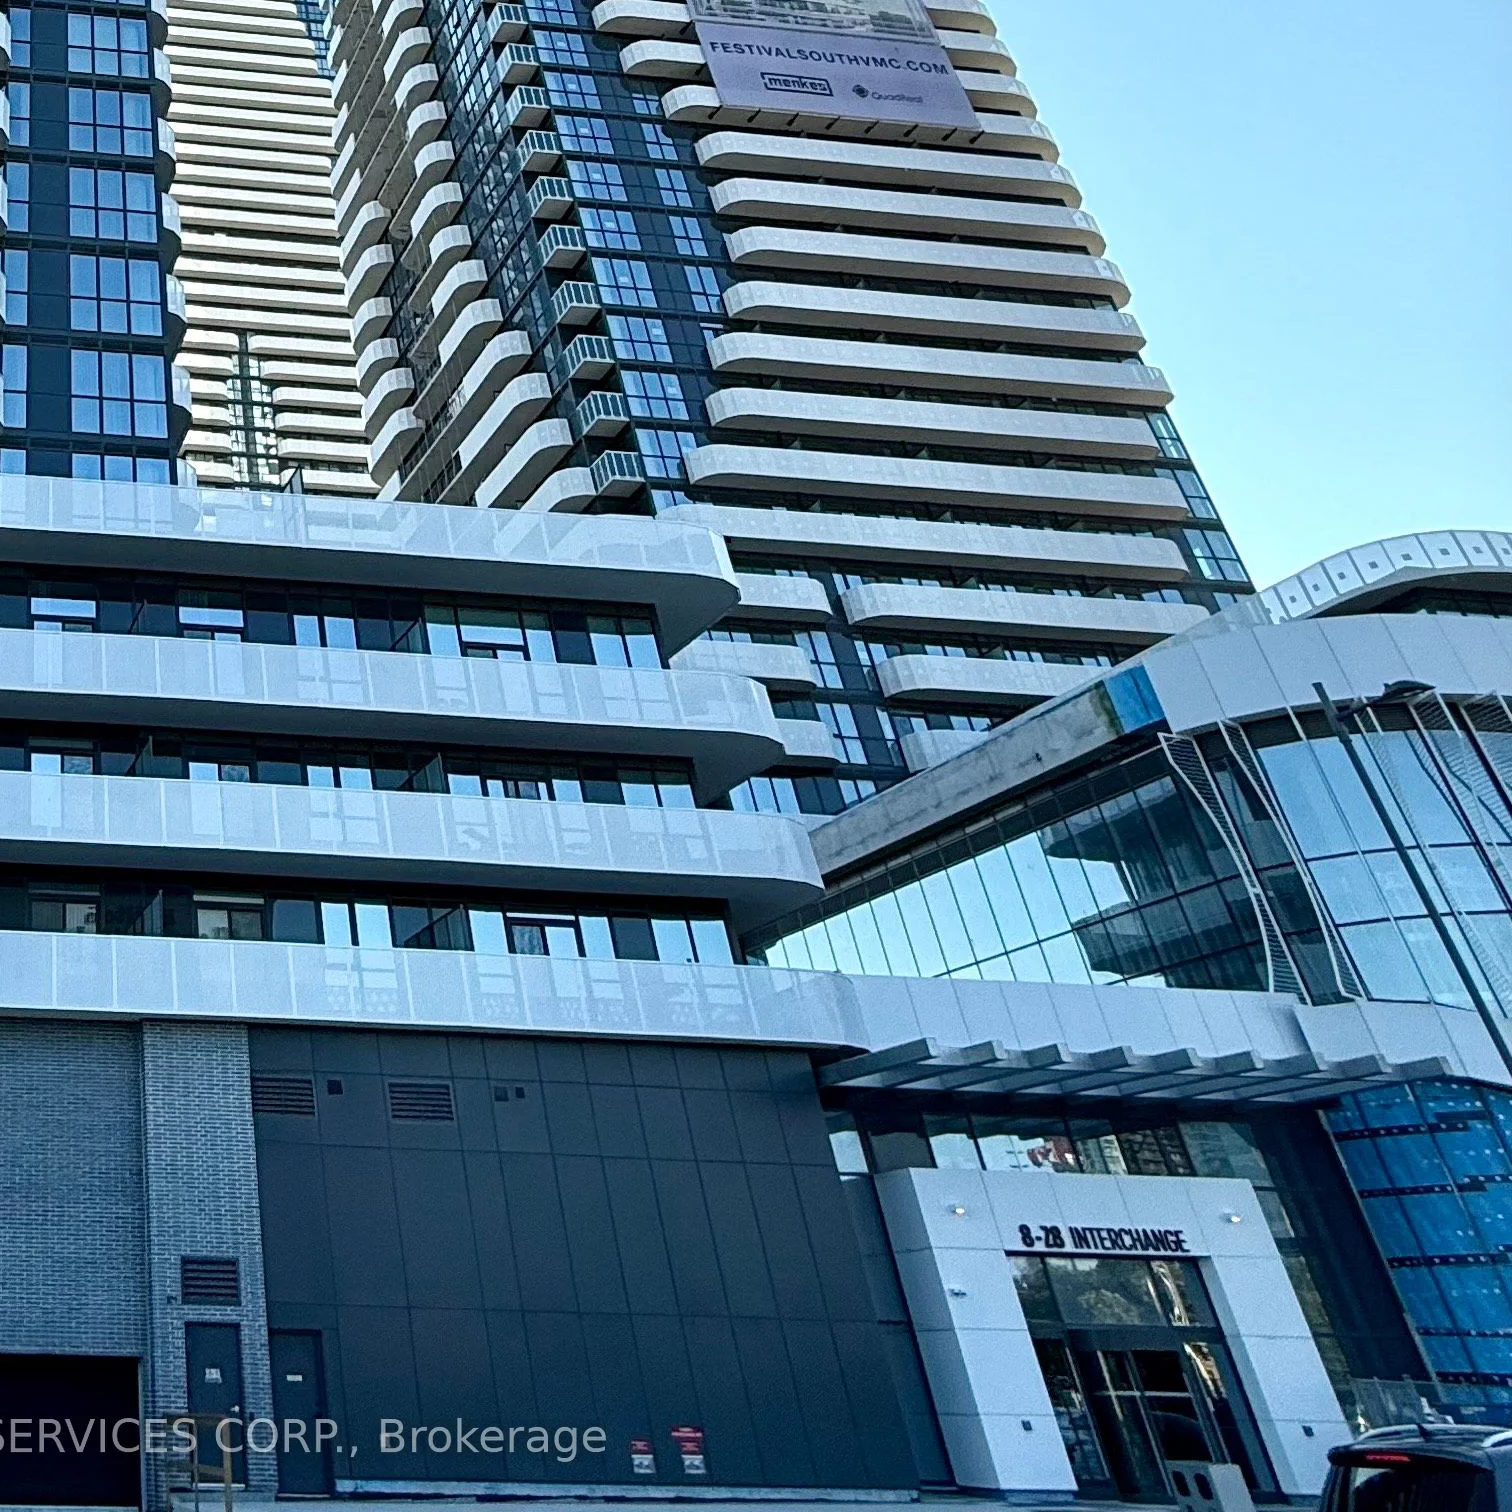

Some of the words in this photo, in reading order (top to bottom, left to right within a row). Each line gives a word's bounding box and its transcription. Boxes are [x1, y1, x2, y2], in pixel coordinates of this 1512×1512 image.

[709, 41, 949, 75] FESTIVALSOUTHVMC.COM
[768, 77, 829, 92] menkes
[1068, 1226, 1191, 1253] INTERCHANGE
